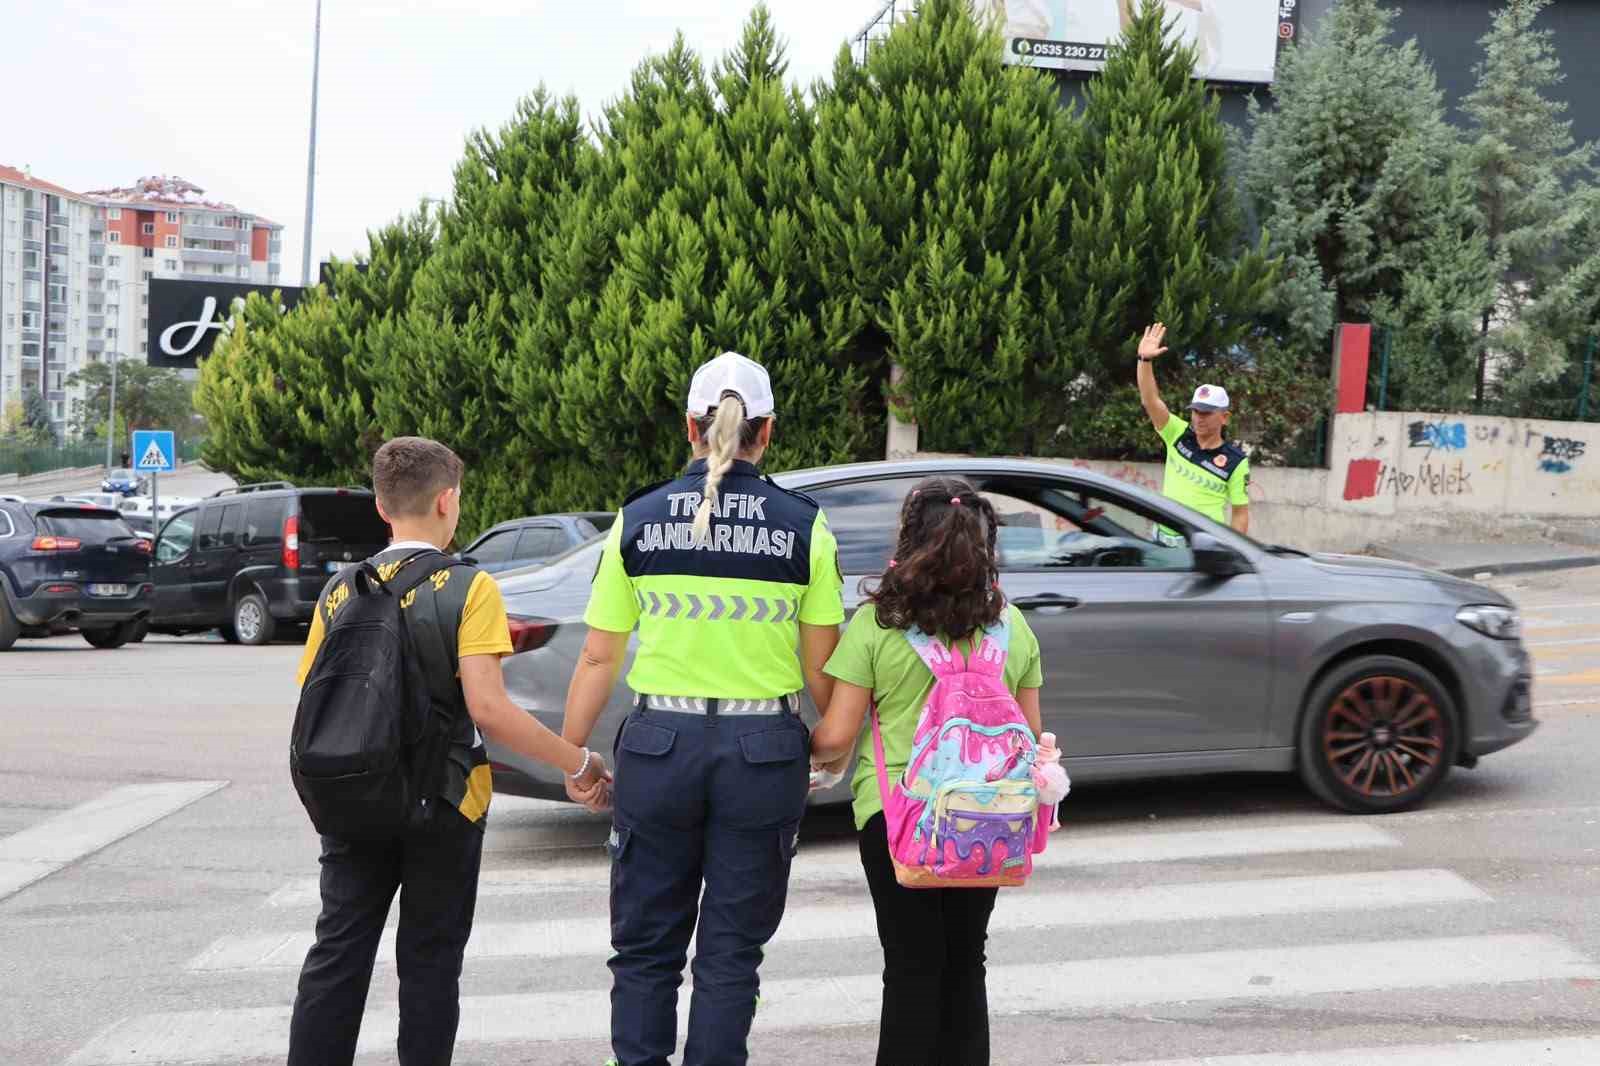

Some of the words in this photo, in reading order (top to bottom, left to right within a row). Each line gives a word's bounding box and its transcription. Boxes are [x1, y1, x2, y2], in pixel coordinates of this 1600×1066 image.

[1033, 43, 1061, 55] 0535
[1065, 46, 1086, 57] 230
[1088, 47, 1103, 58] 27
[636, 522, 795, 559] JANDARMASI
